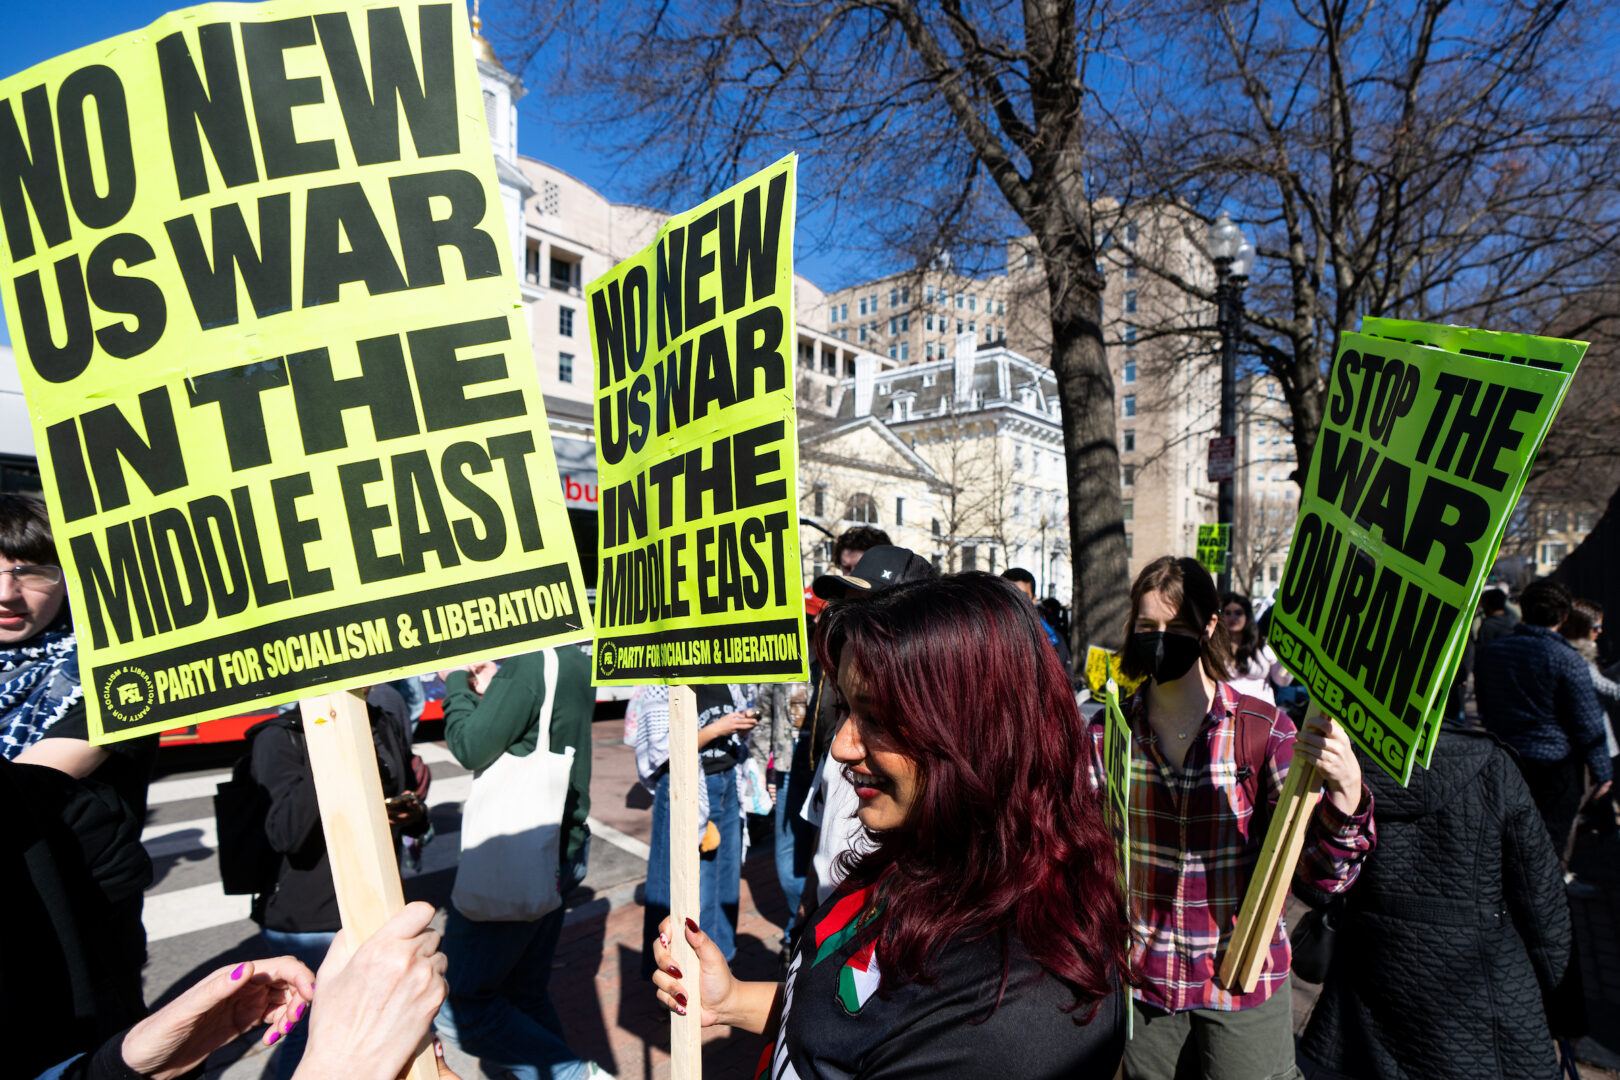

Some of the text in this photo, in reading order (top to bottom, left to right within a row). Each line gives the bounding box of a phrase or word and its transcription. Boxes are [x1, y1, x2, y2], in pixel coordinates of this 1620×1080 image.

[0, 3, 460, 262] NO NEW
[13, 168, 502, 384] US WAR
[591, 170, 788, 390] NO NEW
[46, 315, 528, 524] IN THE
[599, 305, 786, 465] US WAR
[1330, 349, 1545, 493] STOP THE
[68, 430, 545, 651] MIDDLE EAST
[602, 419, 787, 549] IN THE
[1317, 428, 1491, 587] WAR
[600, 510, 789, 629] MIDDLE EAST
[1281, 512, 1460, 732] ON IRAN!
[103, 669, 122, 711] SOCIALISM
[117, 683, 144, 705] PSL
[129, 705, 151, 722] PARTY
[130, 666, 155, 705] LIBERATION
[154, 581, 574, 704] PARTY FOR SOCIALISM & LIBERATION
[617, 645, 645, 669] PARTY
[646, 644, 660, 668] FOR
[713, 638, 723, 665] &
[723, 633, 798, 666] LIBERATION
[1271, 622, 1405, 771] PSLWEB.ORG
[112, 710, 128, 722] FOR
